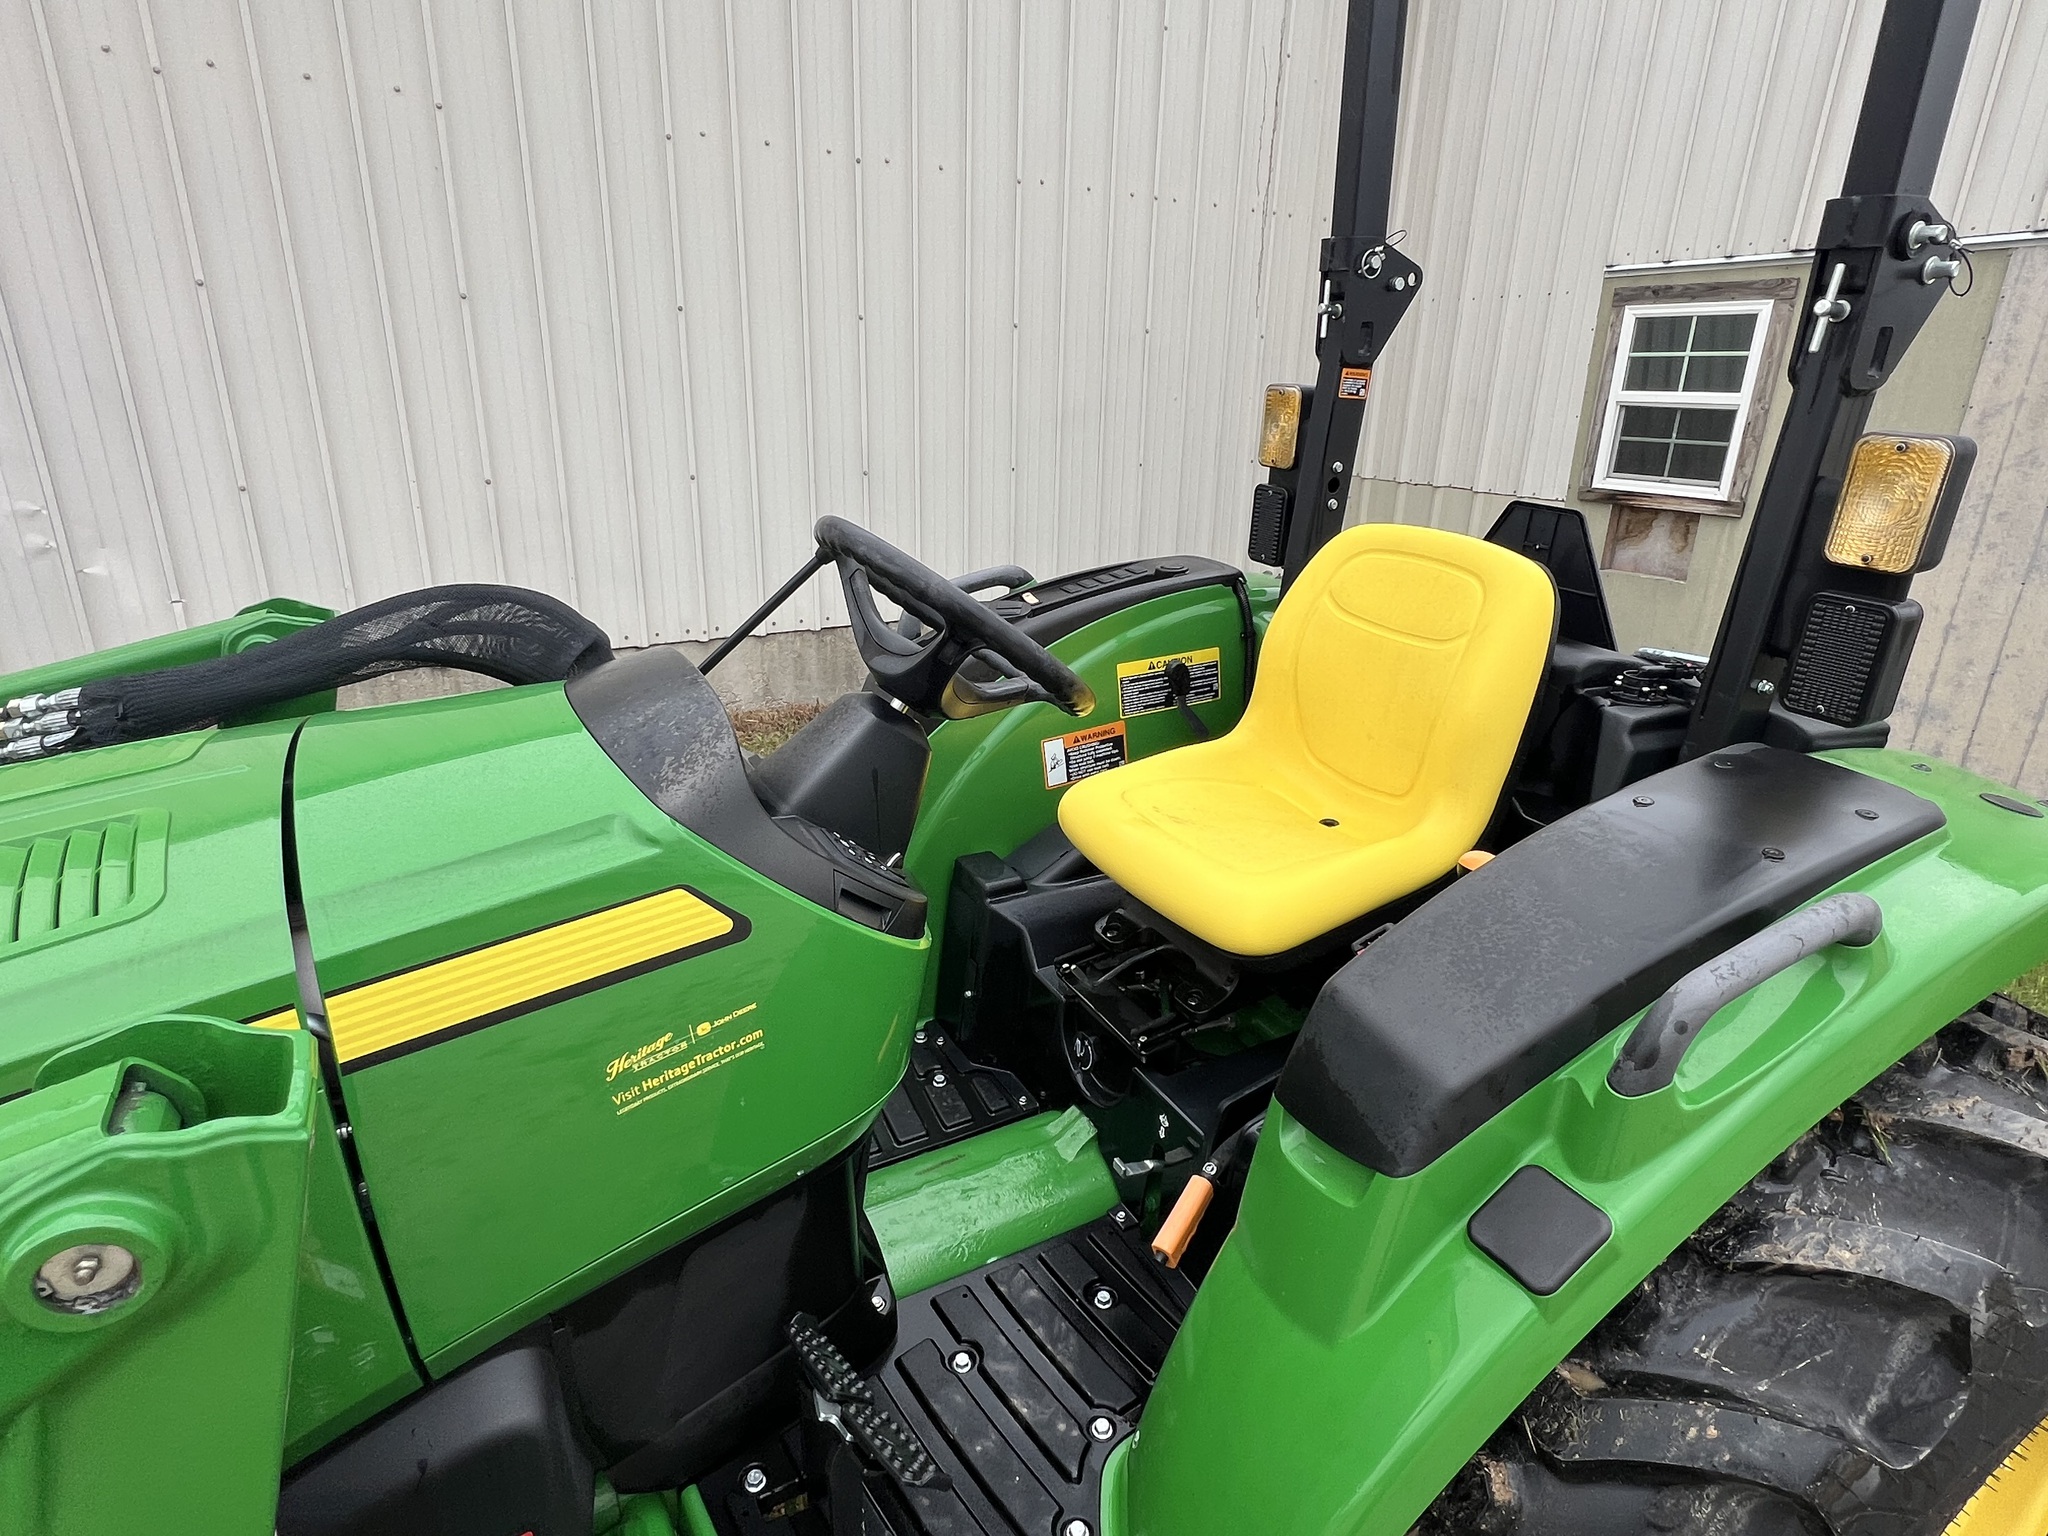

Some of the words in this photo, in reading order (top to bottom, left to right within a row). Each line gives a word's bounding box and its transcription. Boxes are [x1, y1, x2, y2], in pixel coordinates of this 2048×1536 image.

[1157, 656, 1193, 669] CAON
[1080, 728, 1116, 741] WARNING
[711, 1014, 733, 1028] JOHN
[606, 1032, 673, 1081] Heritage
[611, 1085, 641, 1106] Visit
[641, 1029, 764, 1092] HeritageTractor.com
